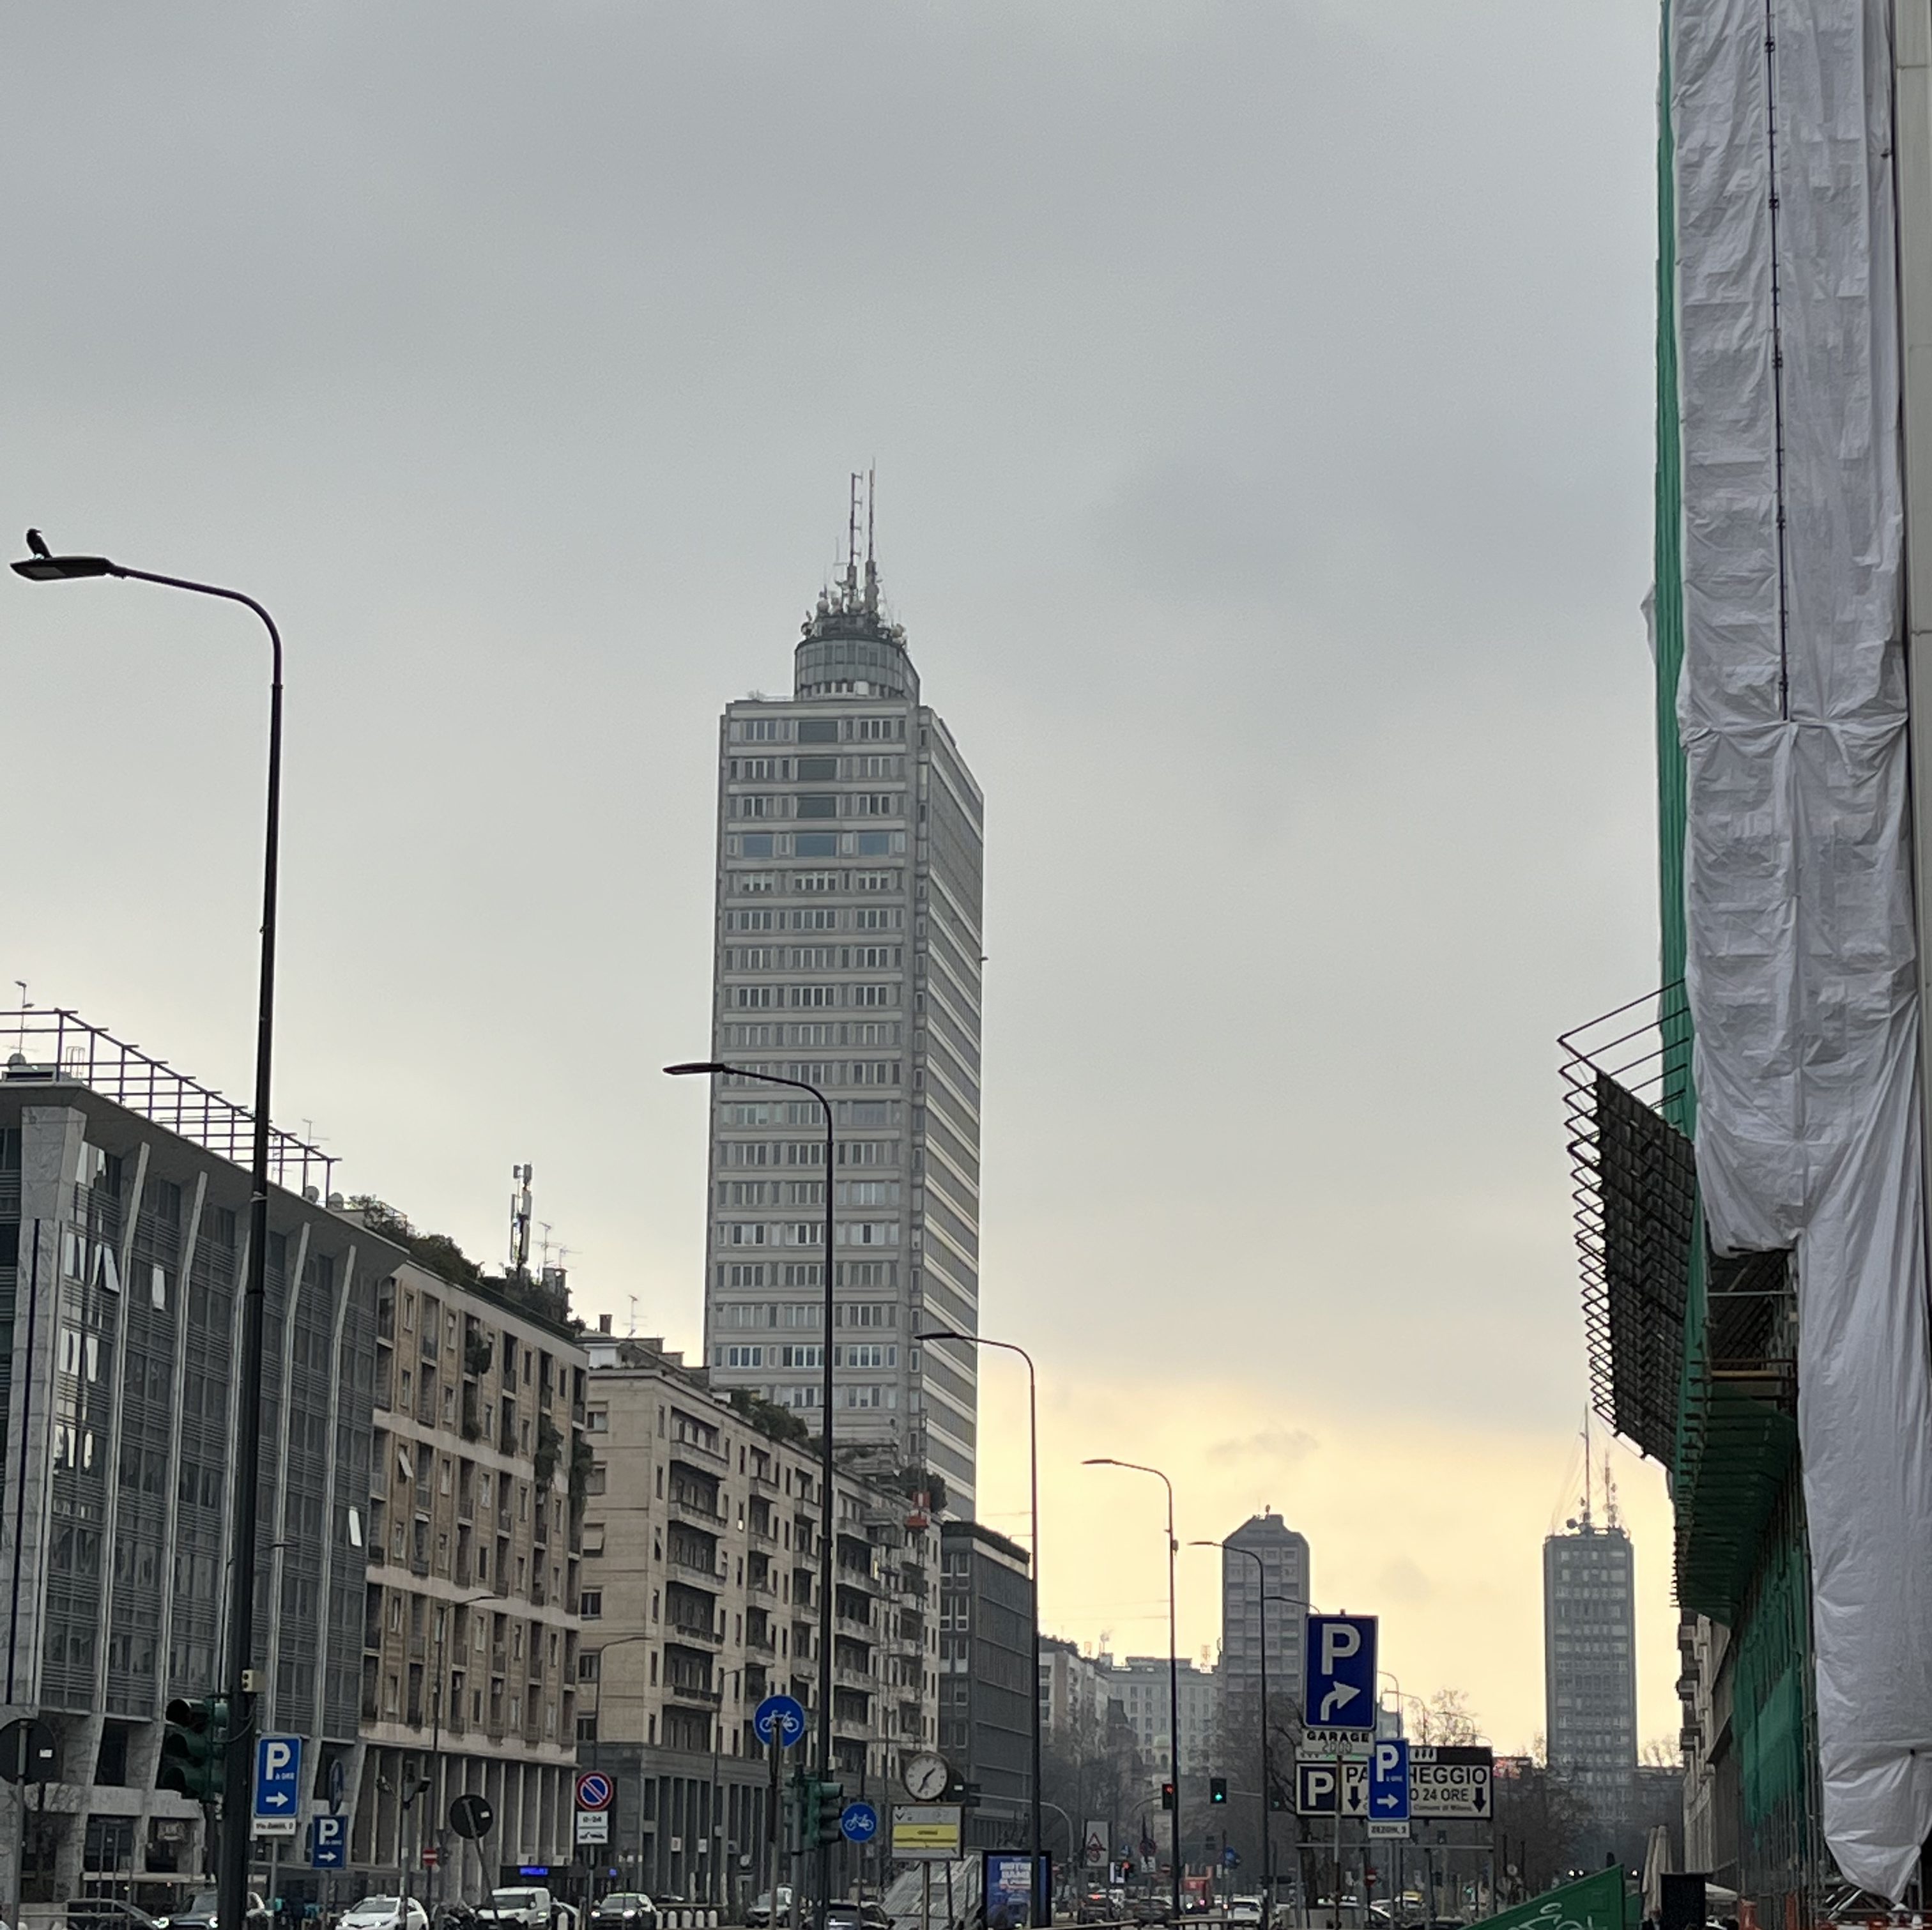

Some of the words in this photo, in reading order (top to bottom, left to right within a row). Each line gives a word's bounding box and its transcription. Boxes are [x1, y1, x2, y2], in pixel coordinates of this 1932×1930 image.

[1321, 1623, 1360, 1675] P
[1307, 1730, 1368, 1744] GARAGE
[266, 1742, 291, 1781] P
[1376, 1744, 1399, 1782] P
[1308, 1771, 1334, 1807] P
[1423, 1788, 1437, 1801] 24
[1441, 1788, 1469, 1802] ORE
[319, 1819, 339, 1845] P
